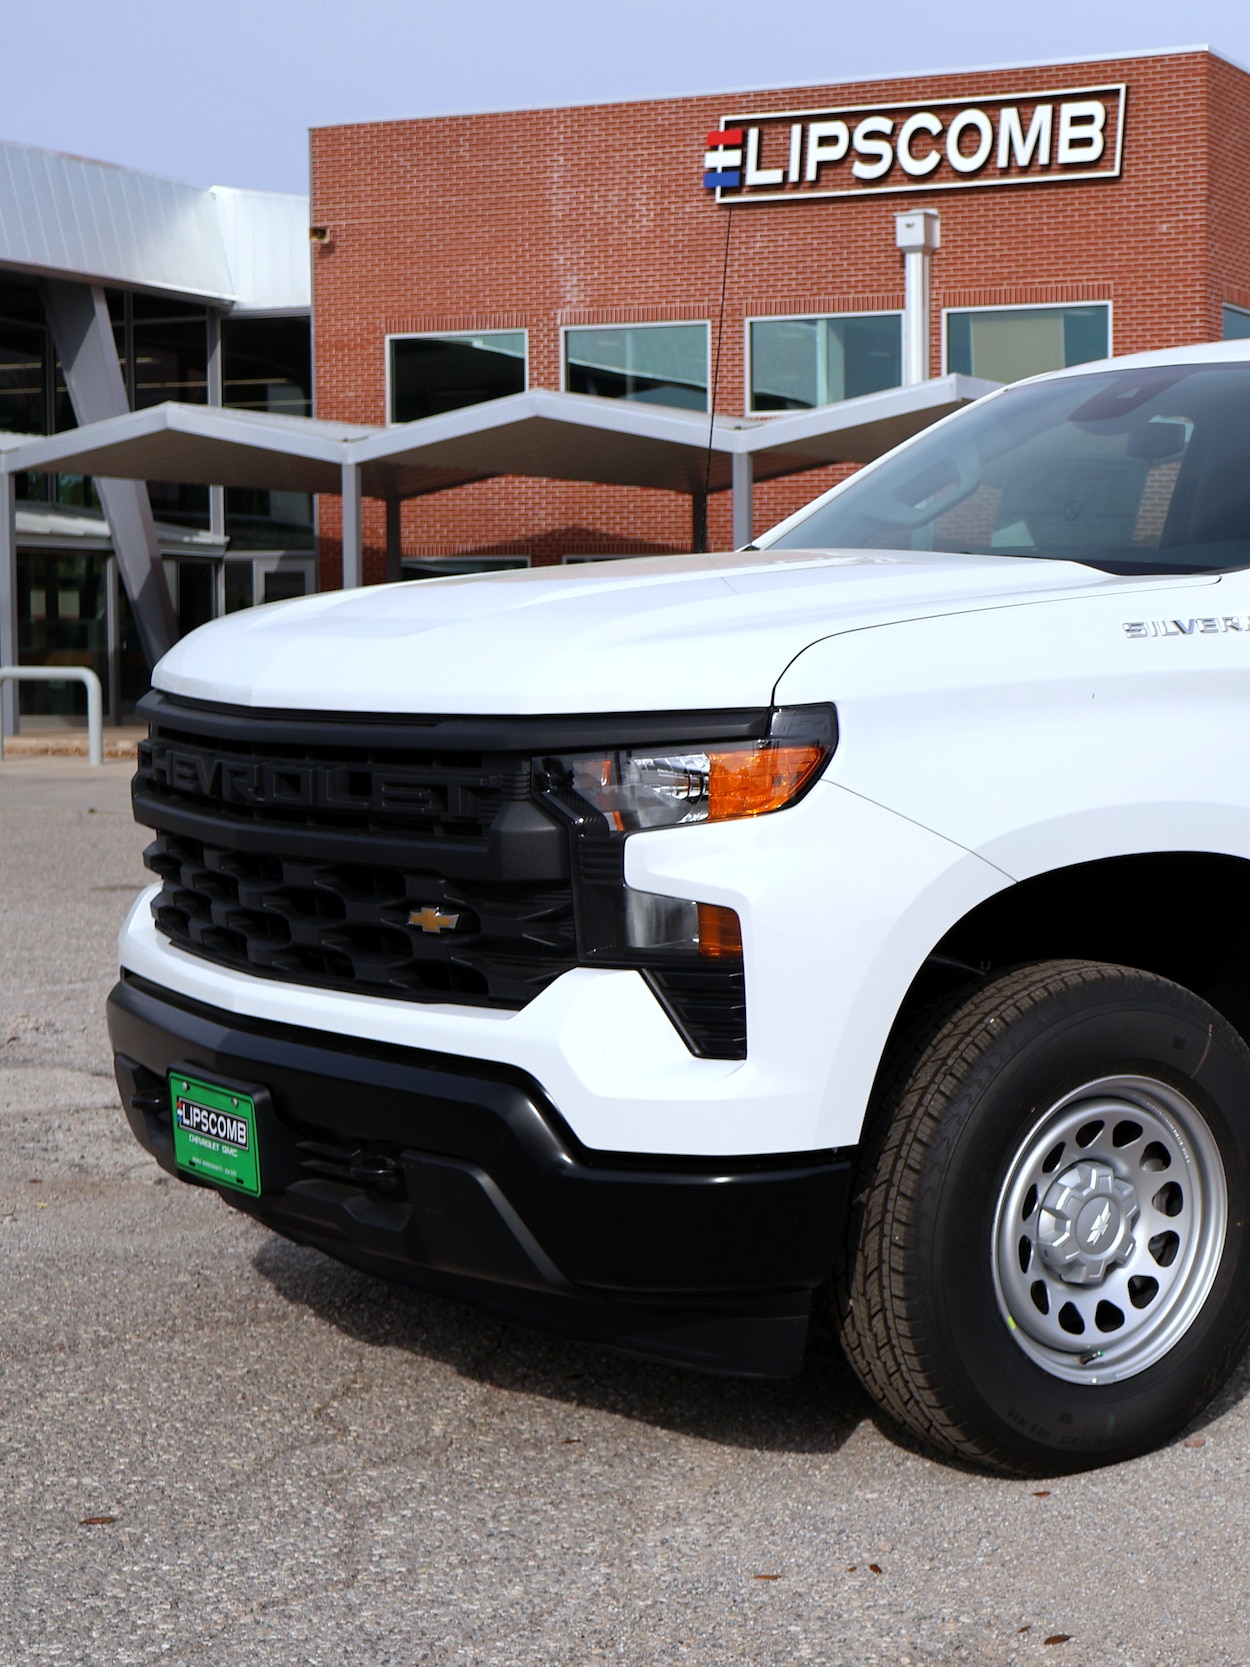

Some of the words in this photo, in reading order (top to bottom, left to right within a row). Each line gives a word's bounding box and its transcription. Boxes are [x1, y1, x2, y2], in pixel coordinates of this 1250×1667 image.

[745, 100, 1107, 186] LIPSCOMB
[182, 1103, 247, 1145] LIPSCOMB
[188, 1134, 220, 1152] CHEVROLET
